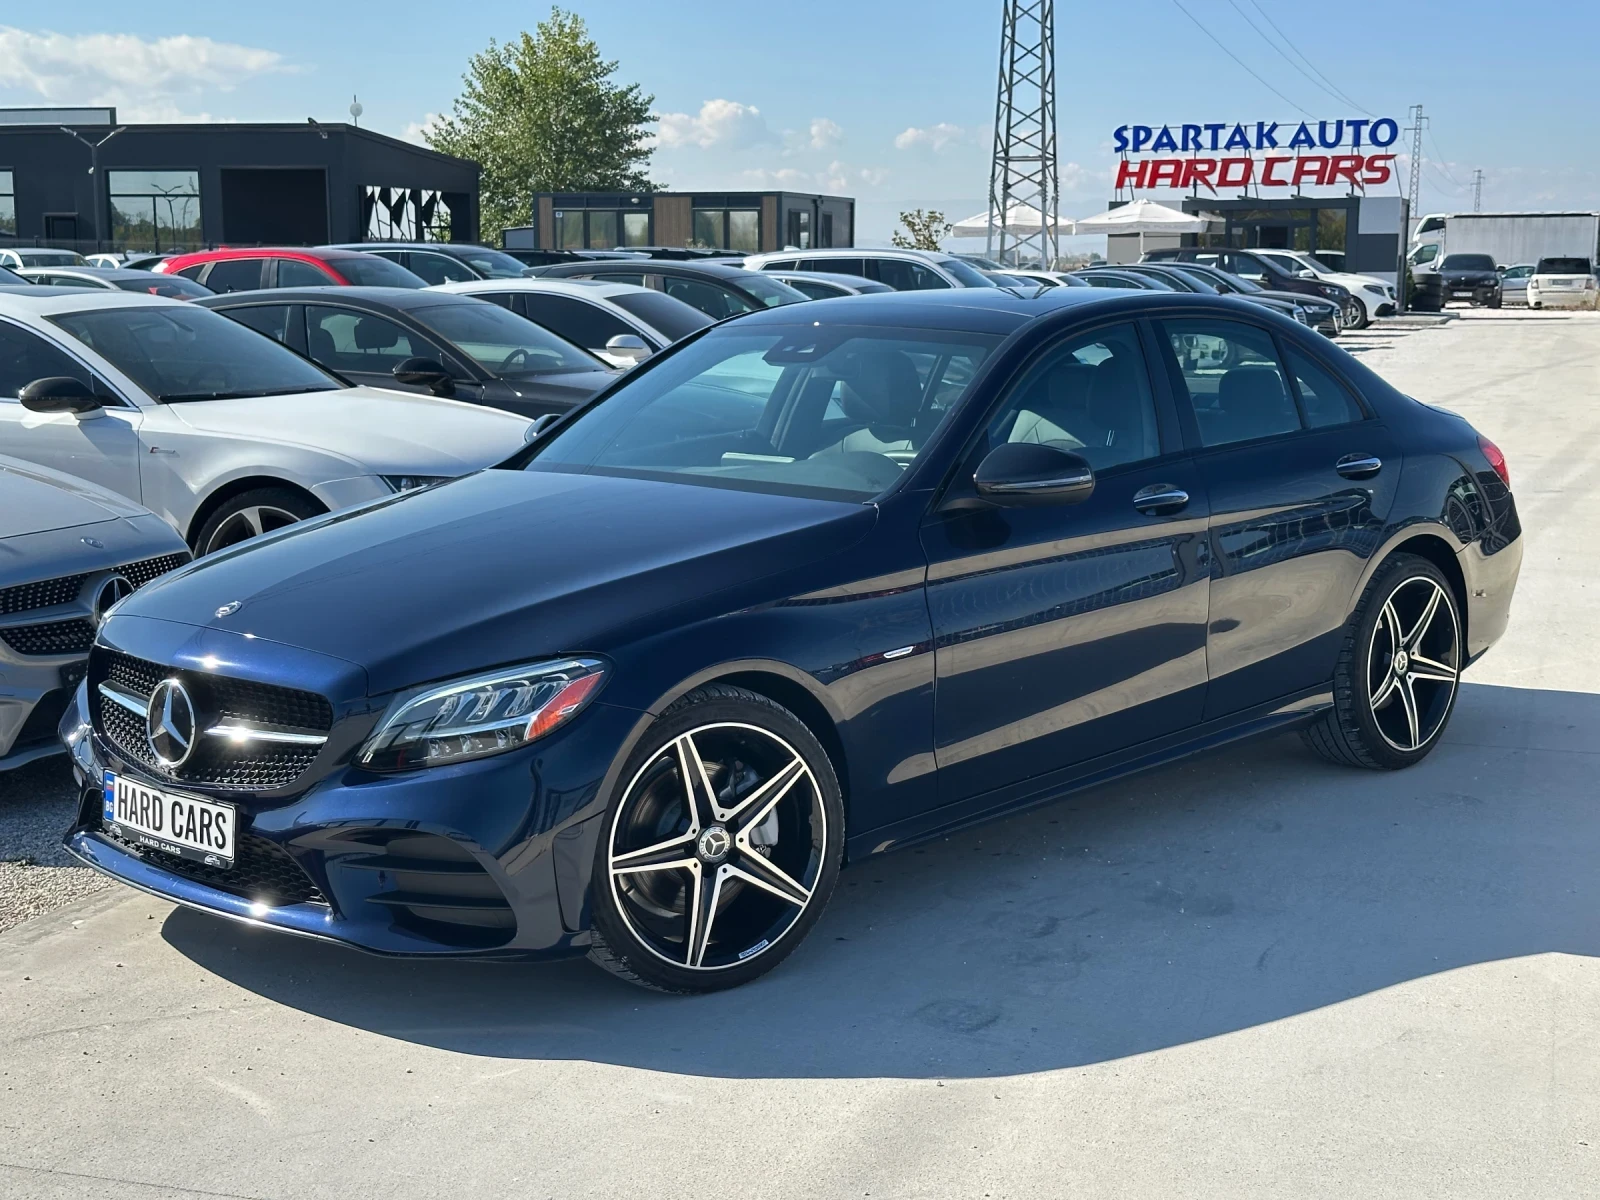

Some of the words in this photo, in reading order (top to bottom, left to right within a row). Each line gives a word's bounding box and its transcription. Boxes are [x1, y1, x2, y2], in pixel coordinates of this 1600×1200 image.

[1113, 122, 1279, 153] SPARTAK
[1288, 118, 1398, 150] AUTO
[1115, 157, 1254, 197] HARD
[1261, 154, 1398, 192] CARS
[105, 800, 114, 813] BG
[118, 782, 163, 831] HARD
[171, 800, 226, 849] CARS
[139, 835, 160, 848] HARD
[160, 842, 181, 855] CARS
